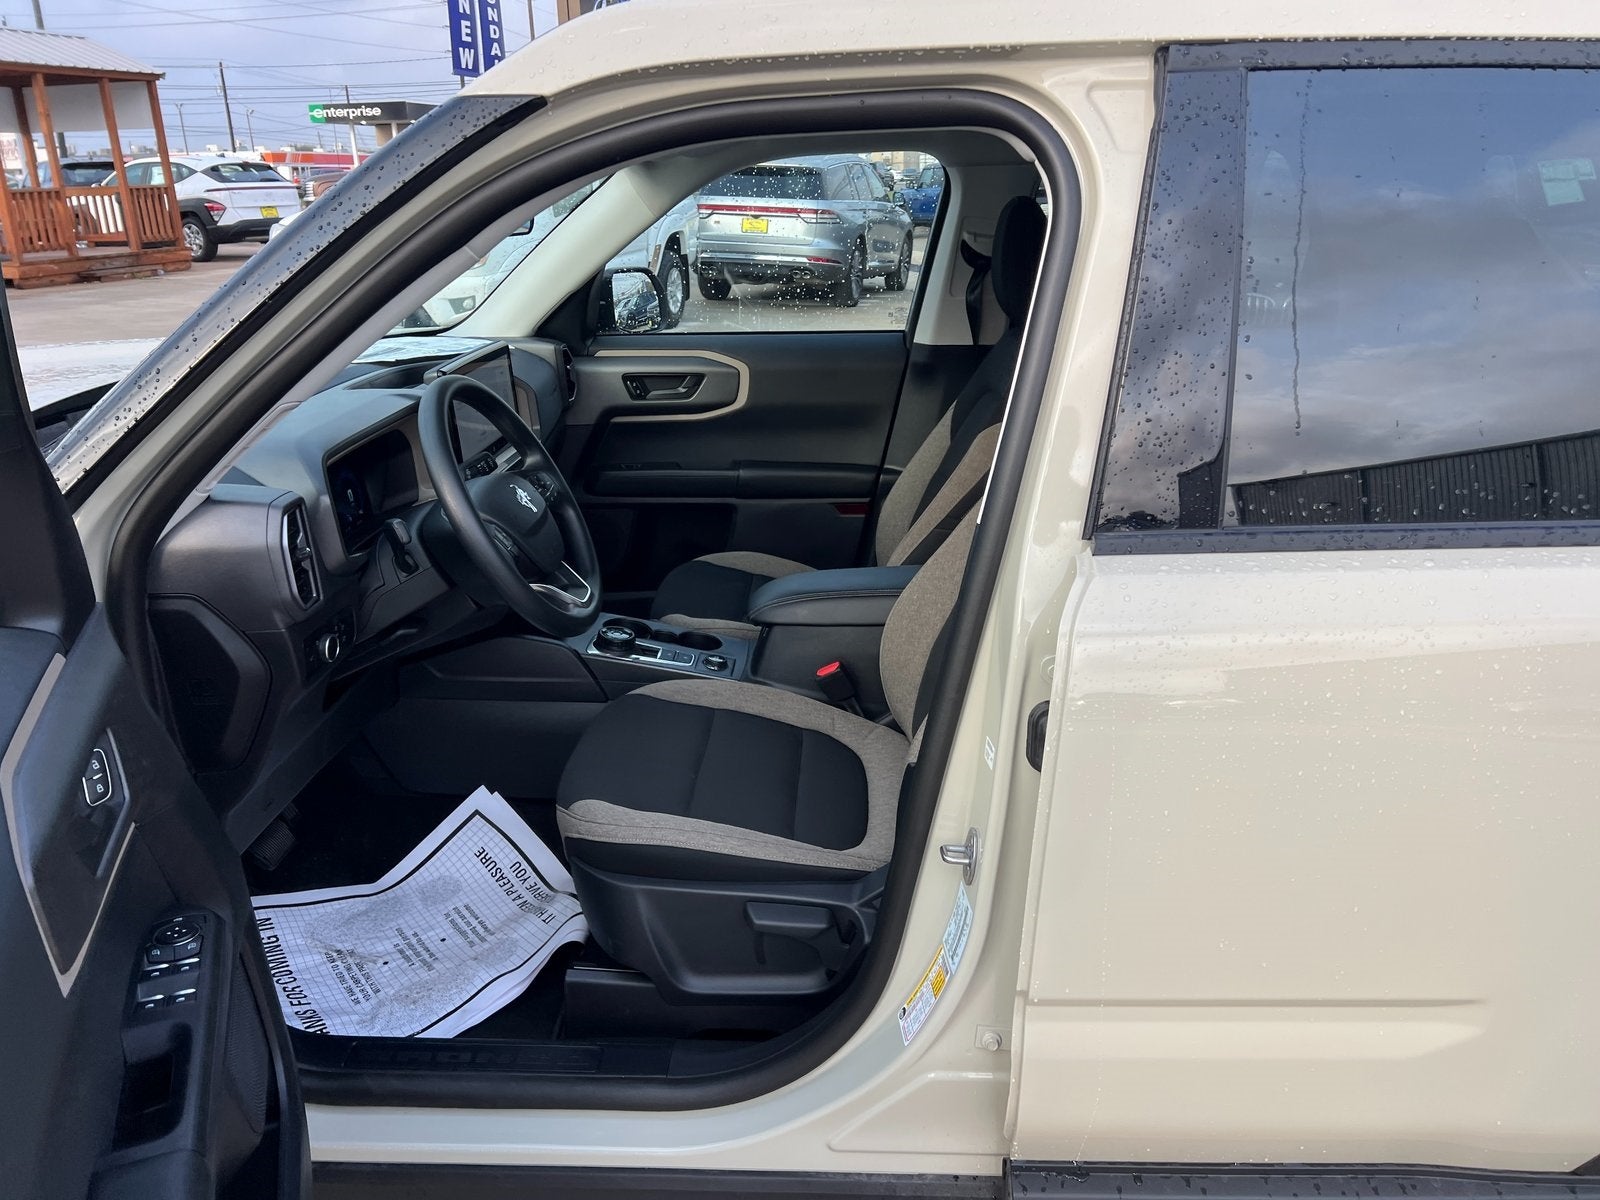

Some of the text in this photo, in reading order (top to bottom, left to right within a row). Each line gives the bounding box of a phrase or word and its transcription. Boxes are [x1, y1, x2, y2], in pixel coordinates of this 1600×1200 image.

[310, 106, 381, 119] enterprise
[473, 845, 519, 897] PLEASURE
[509, 860, 532, 885] YOU
[511, 892, 525, 905] A
[256, 916, 276, 933] IN
[541, 913, 557, 925] IT
[261, 934, 298, 987] COMING
[330, 964, 340, 972] TO
[281, 985, 312, 1008] FOR
[358, 986, 372, 1003] YOUR
